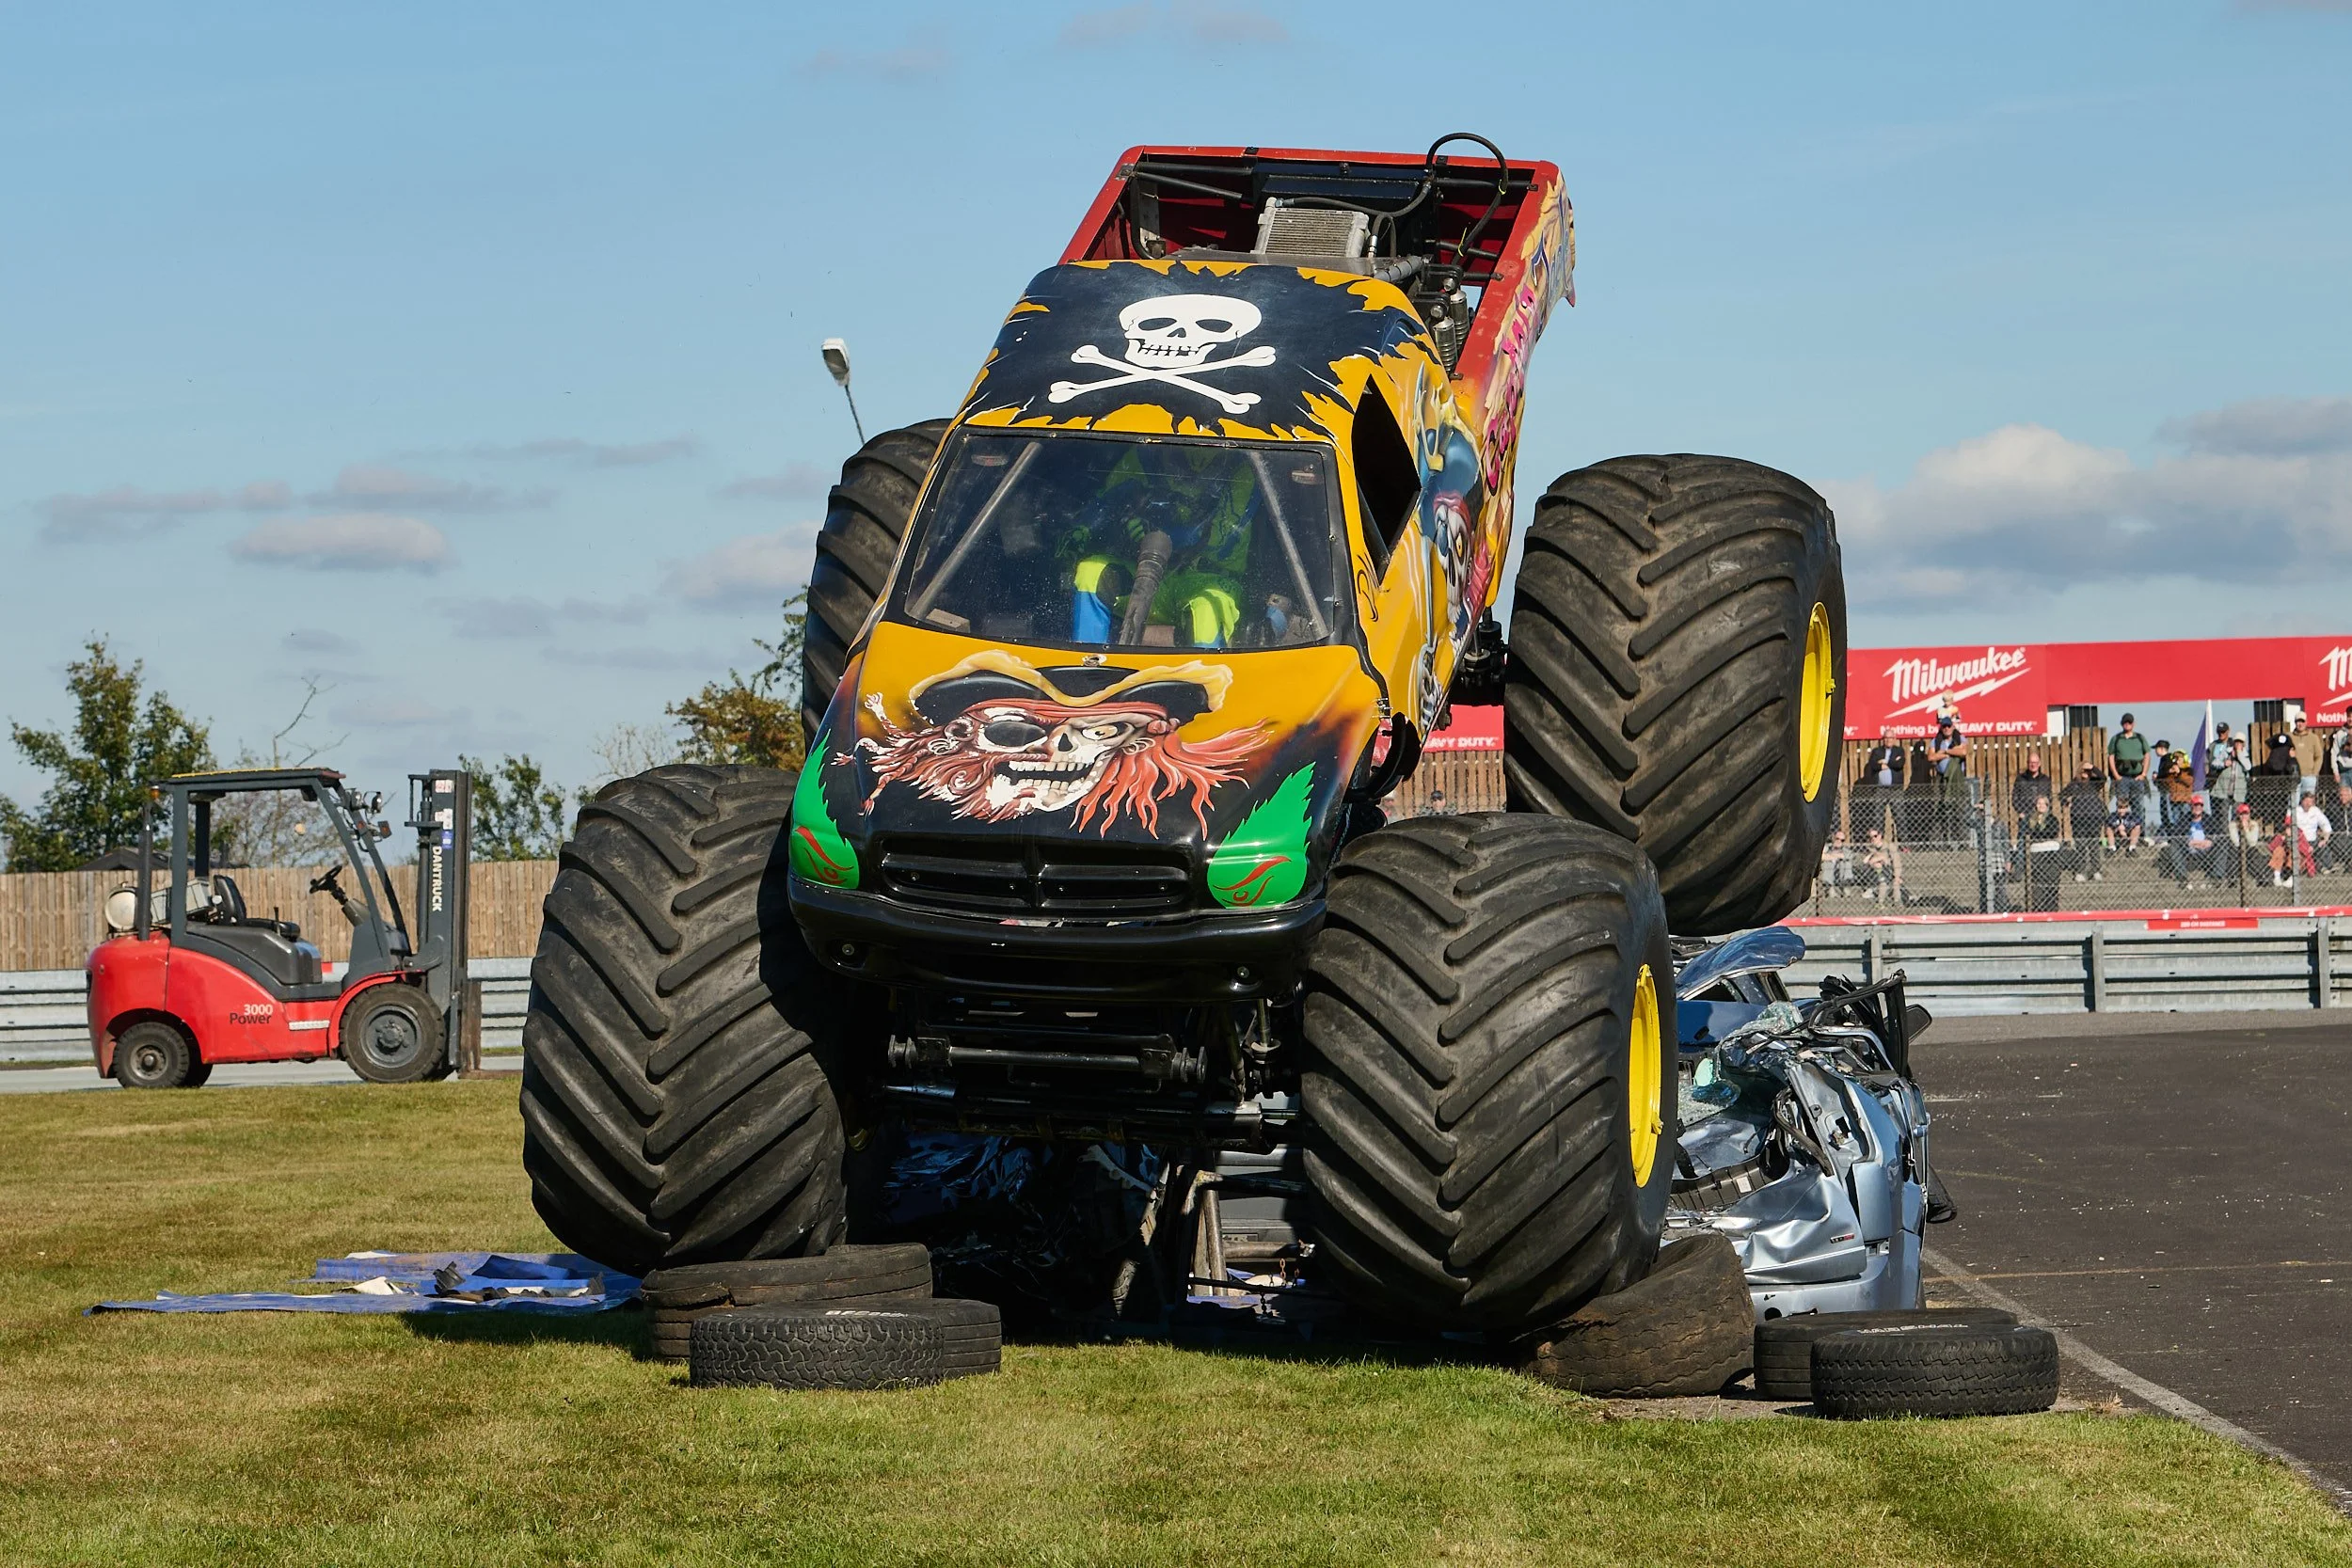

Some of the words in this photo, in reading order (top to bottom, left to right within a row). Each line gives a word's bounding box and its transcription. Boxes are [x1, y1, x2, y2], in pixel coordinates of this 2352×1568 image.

[1882, 646, 2026, 704] Milwaukee
[2316, 712, 2347, 723] Nothi
[432, 846, 442, 912] DANTRUCK
[244, 1004, 274, 1015] 3000
[229, 1012, 272, 1025] Power
